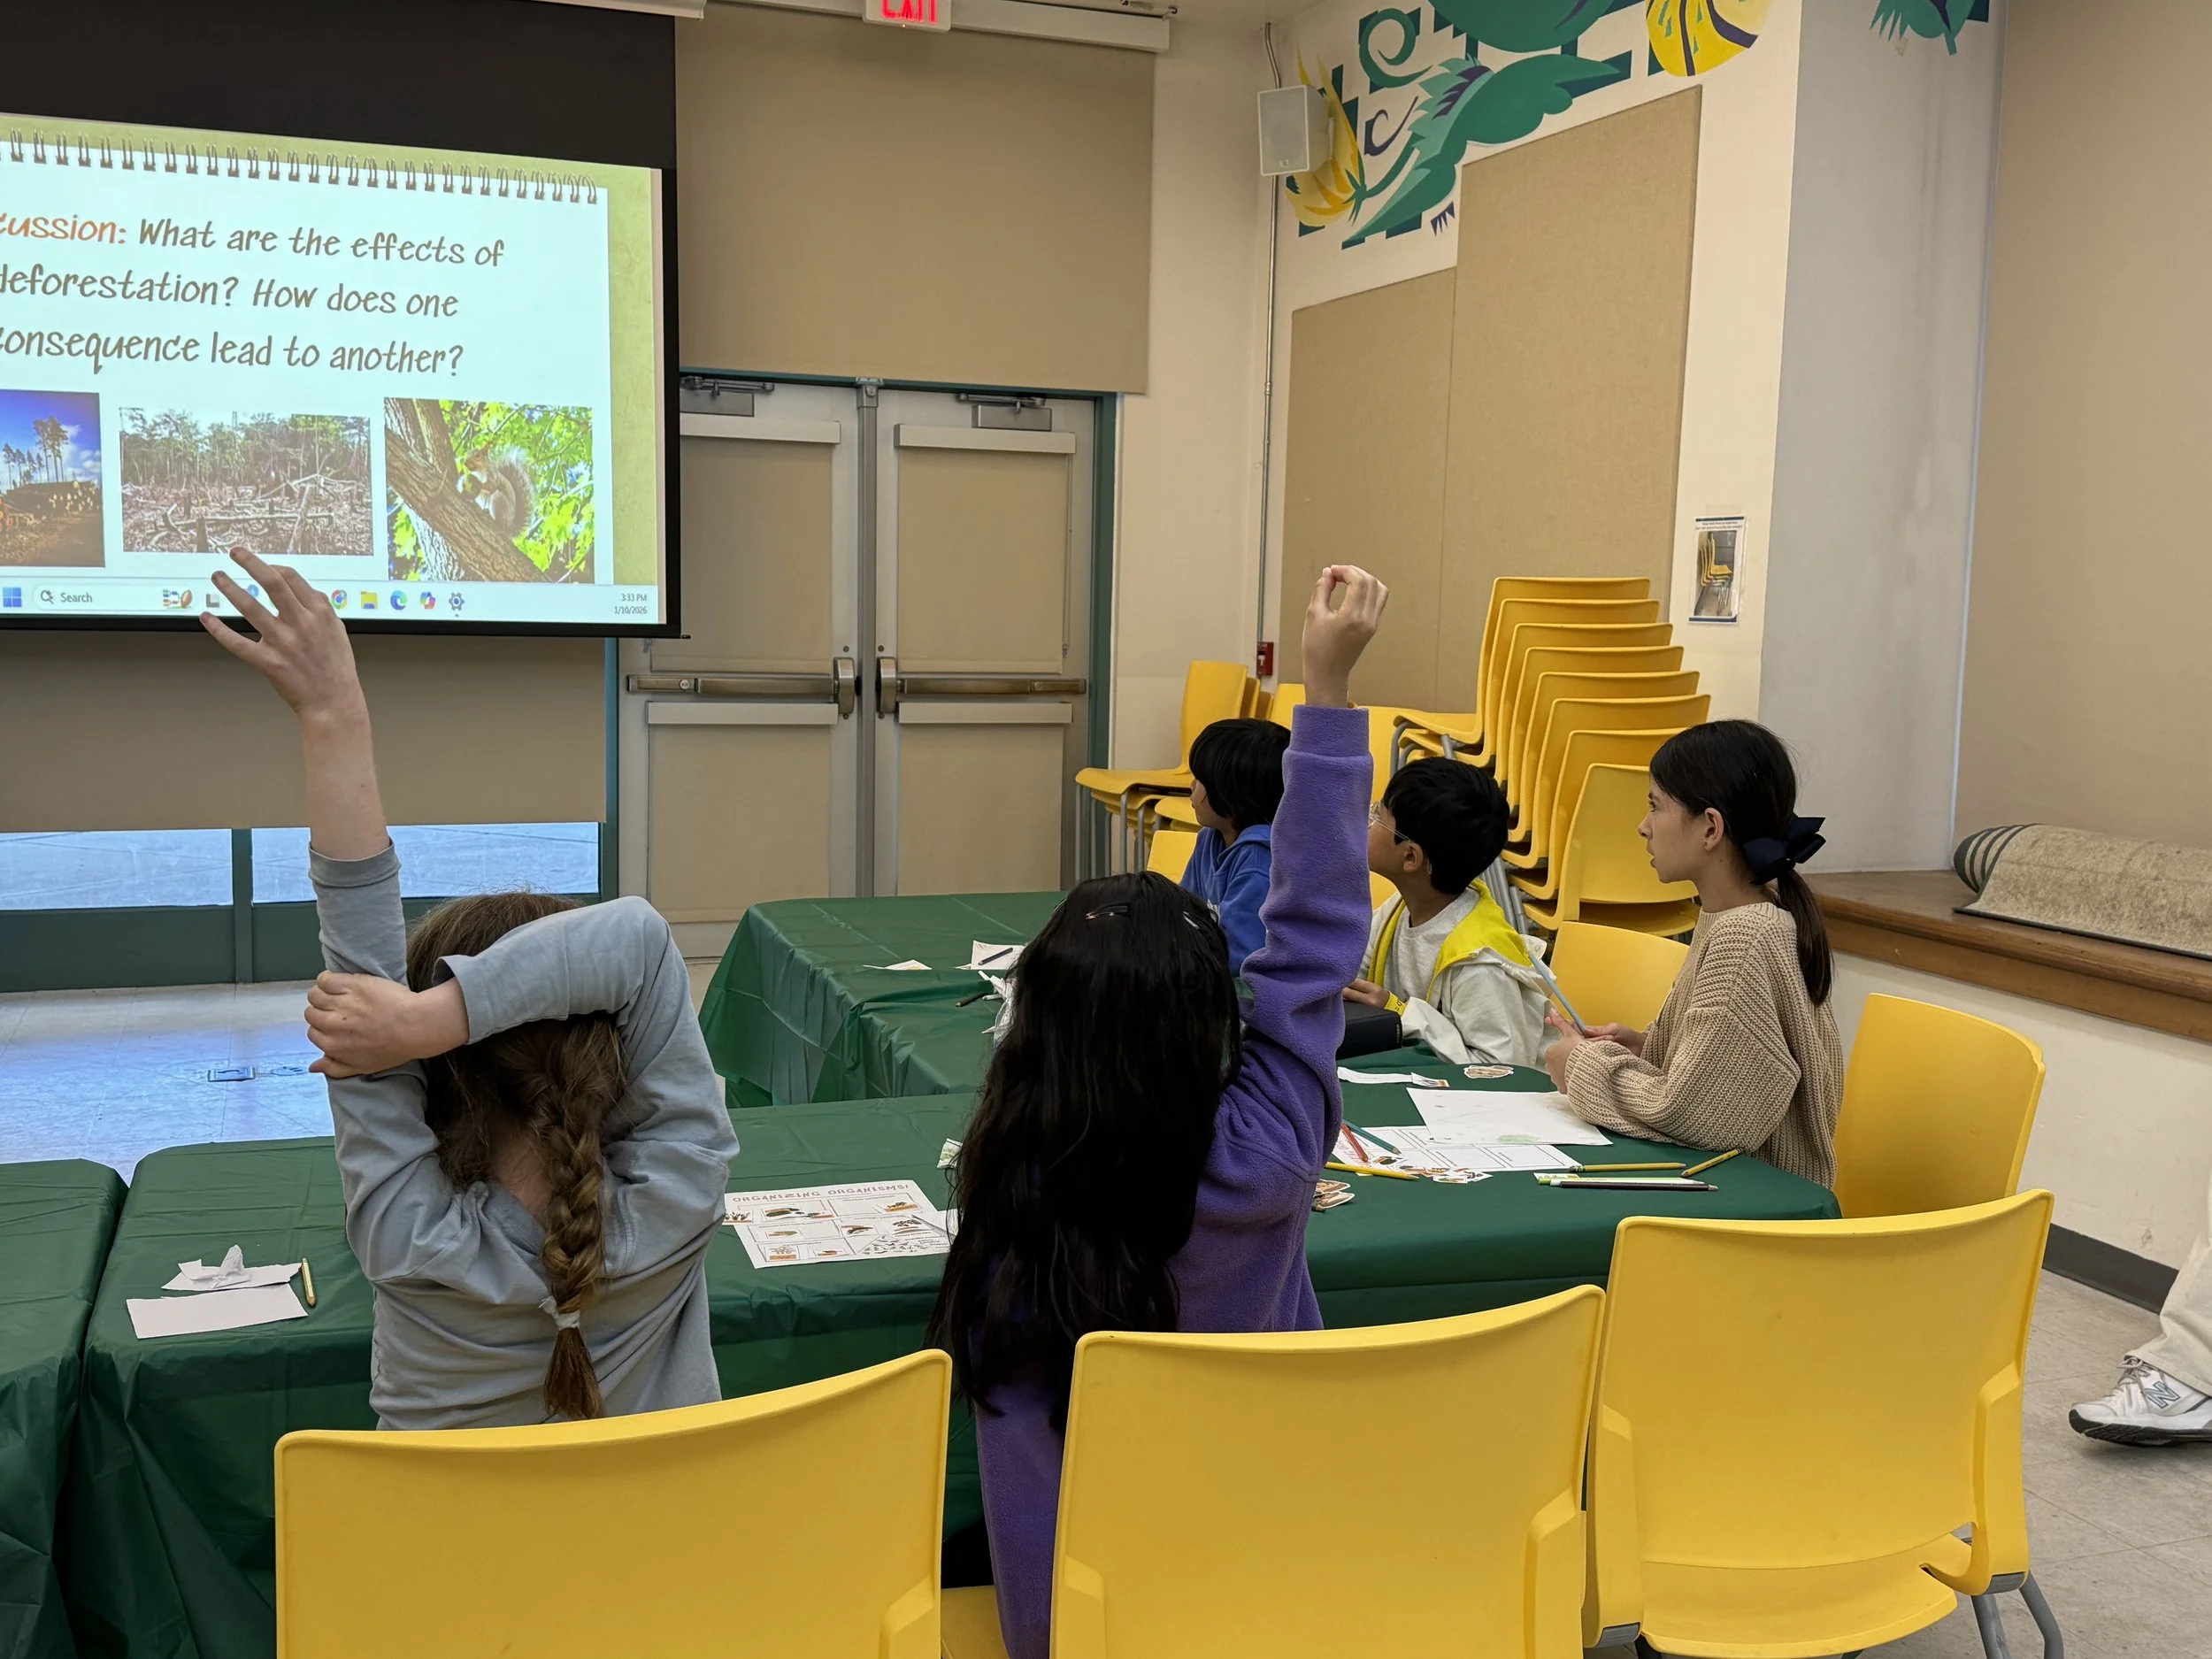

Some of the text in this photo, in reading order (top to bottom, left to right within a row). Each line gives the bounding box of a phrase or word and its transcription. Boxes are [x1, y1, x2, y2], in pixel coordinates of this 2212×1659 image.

[139, 218, 217, 249] What
[227, 229, 278, 252] are
[288, 227, 341, 257] the
[351, 232, 465, 265] effects
[475, 239, 504, 267] of
[252, 278, 319, 309] How
[326, 282, 397, 314] does
[406, 293, 459, 318] one
[0, 327, 465, 377] onsequence lead to another?
[60, 592, 93, 603] Search
[636, 593, 648, 602] PM
[733, 1191, 821, 1202] ORGANIZING
